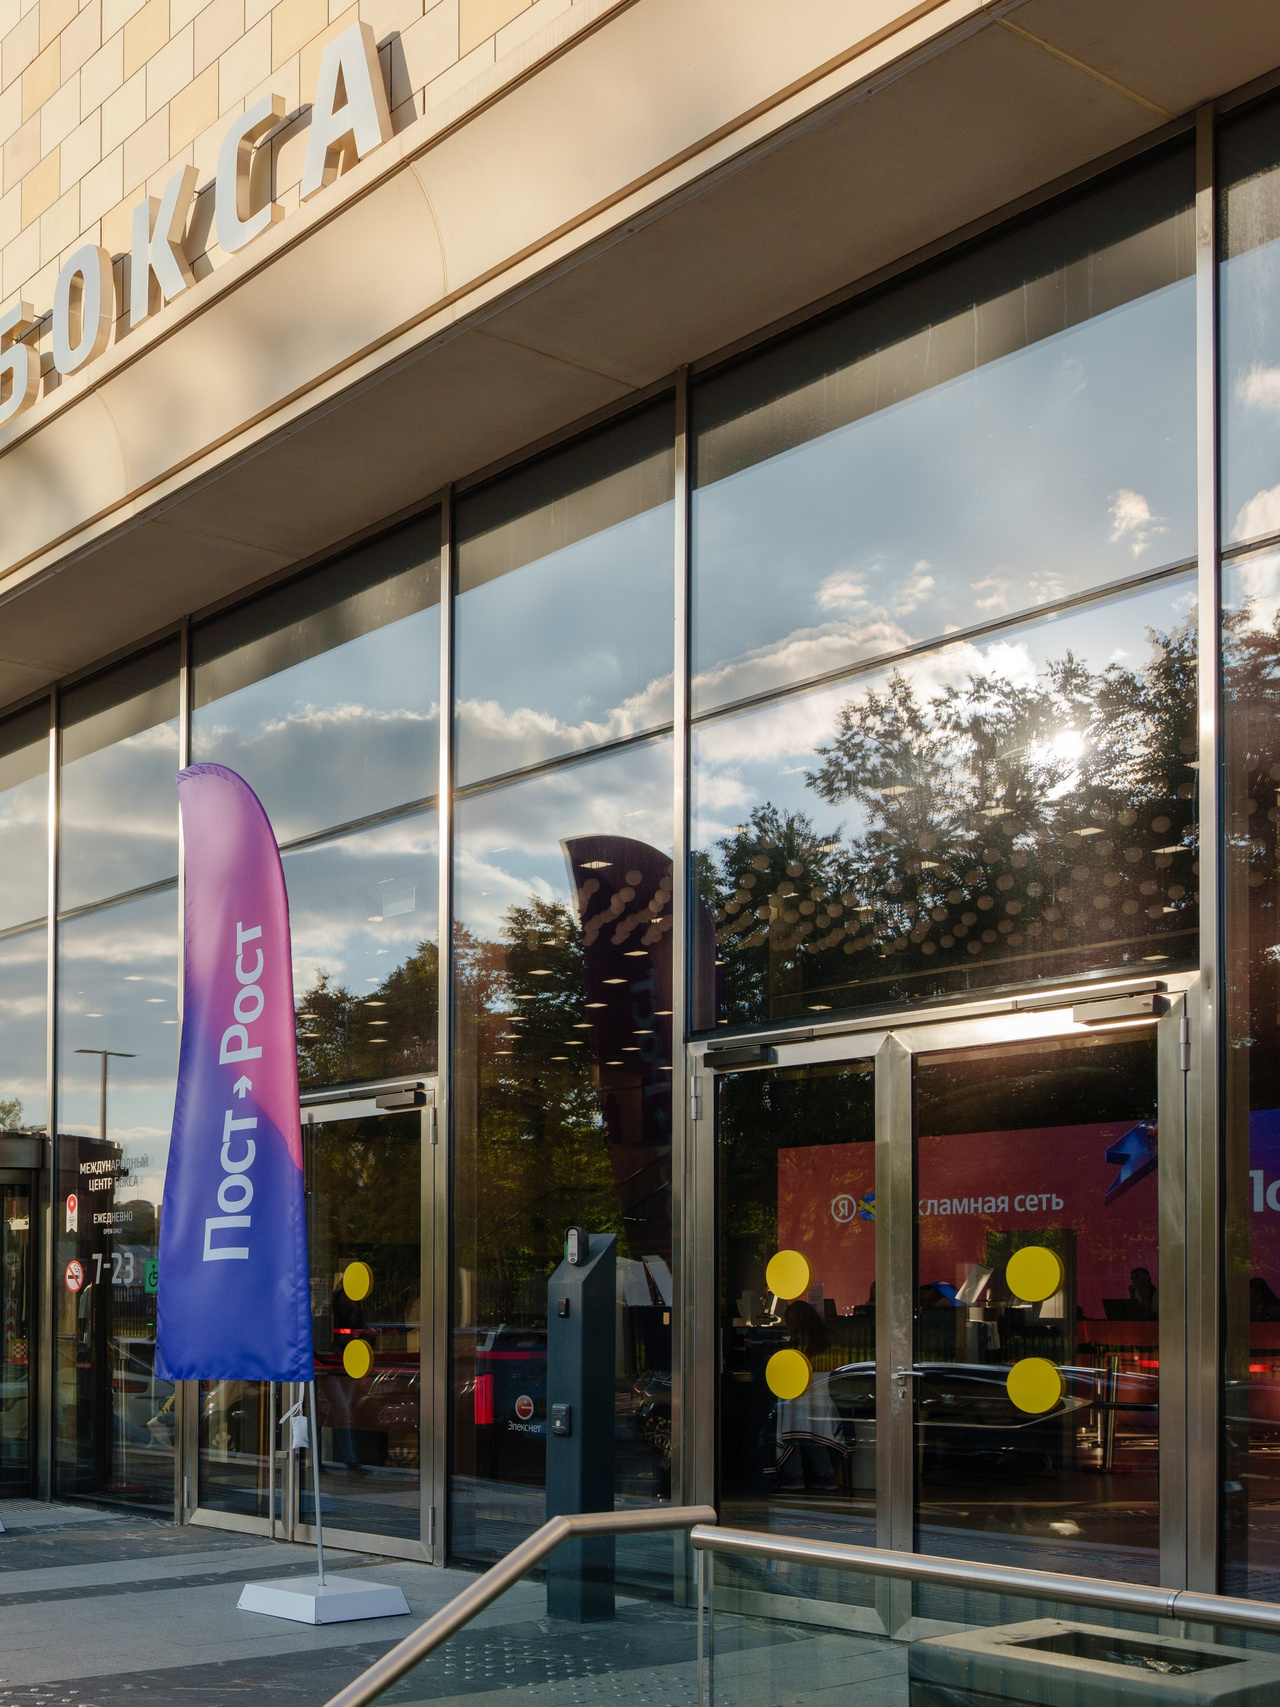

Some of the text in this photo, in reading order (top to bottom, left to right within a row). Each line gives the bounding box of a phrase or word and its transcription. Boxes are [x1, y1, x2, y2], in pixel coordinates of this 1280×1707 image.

[203, 921, 264, 1261] Пост Рост
[80, 1154, 149, 1174] МЕЖДУНАРОДНЫЙ
[89, 1175, 139, 1192] ЦЕНТР БОКСА
[1014, 1194, 1064, 1212] сеть
[93, 1211, 134, 1225] ЕЖЕДНЕВНО
[91, 1252, 134, 1284] 7-23
[508, 1420, 542, 1432] Элекснет
